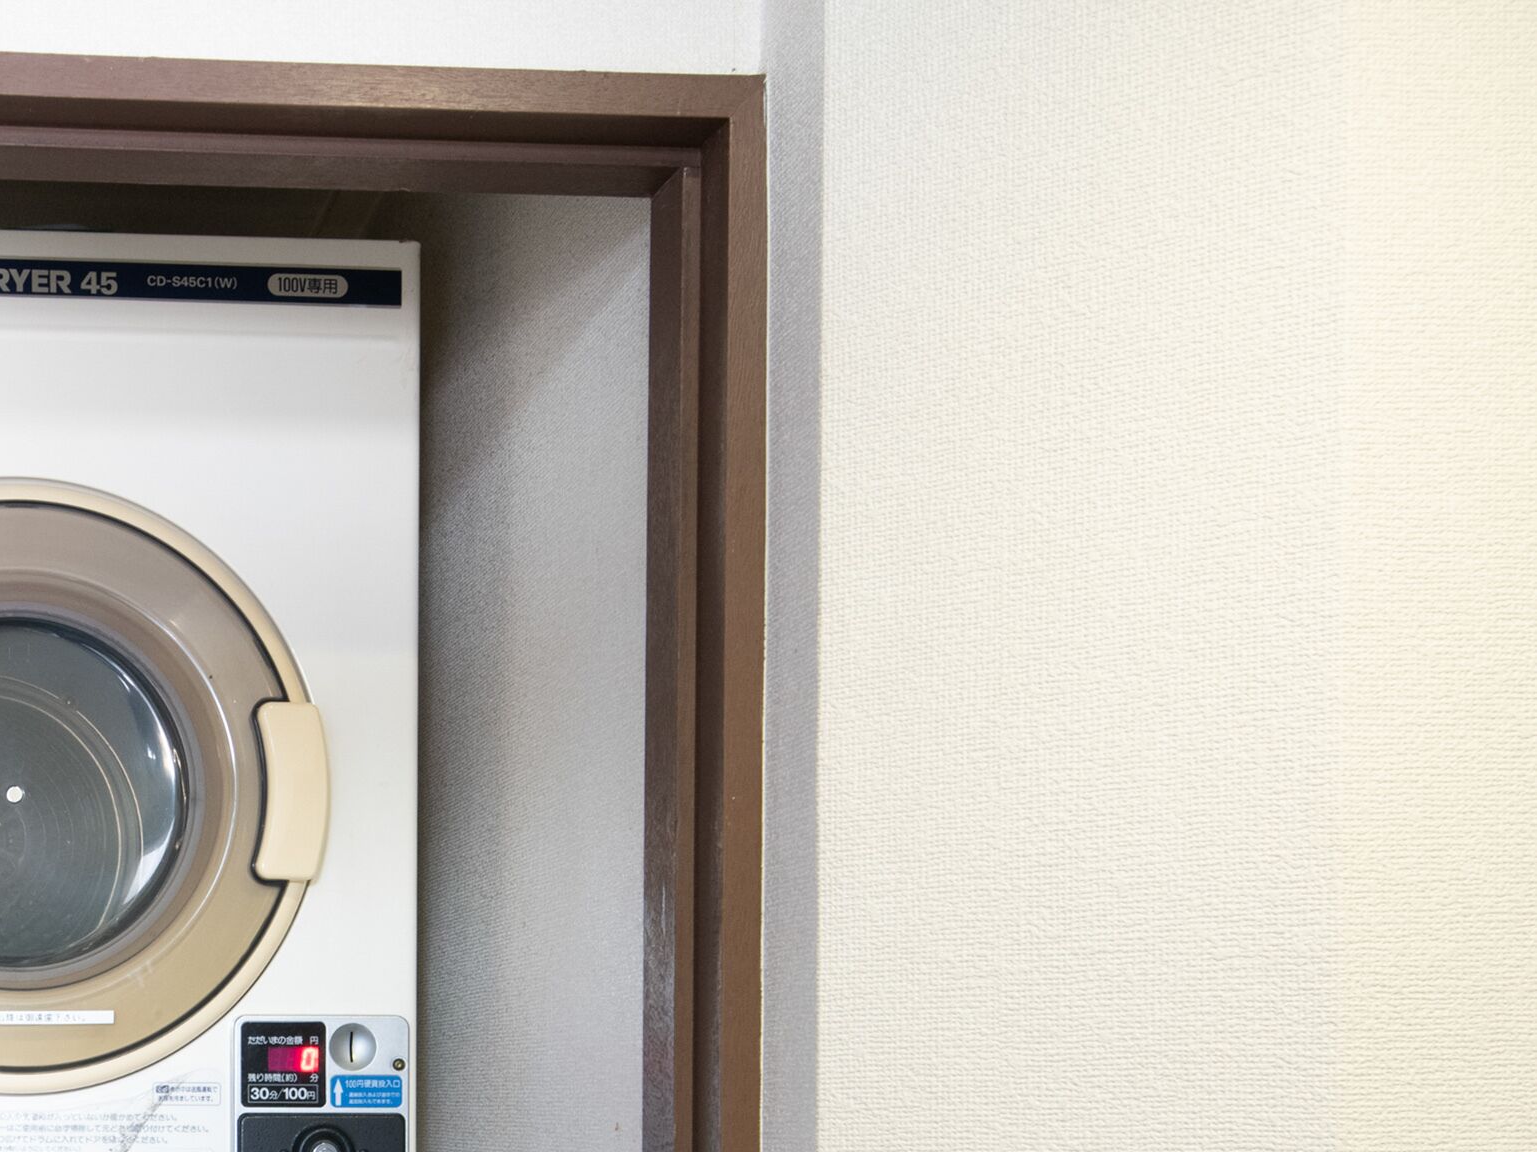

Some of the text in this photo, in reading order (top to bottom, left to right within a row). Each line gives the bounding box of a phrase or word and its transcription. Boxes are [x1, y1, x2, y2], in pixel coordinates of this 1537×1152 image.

[80, 271, 119, 296] 45
[146, 275, 238, 291] CD-S45C1(W)
[277, 276, 339, 296] 100V専用
[309, 1035, 319, 1046] 円
[300, 1047, 319, 1072] 0
[309, 1073, 319, 1083] 分
[249, 1086, 317, 1101] 30分/100円
